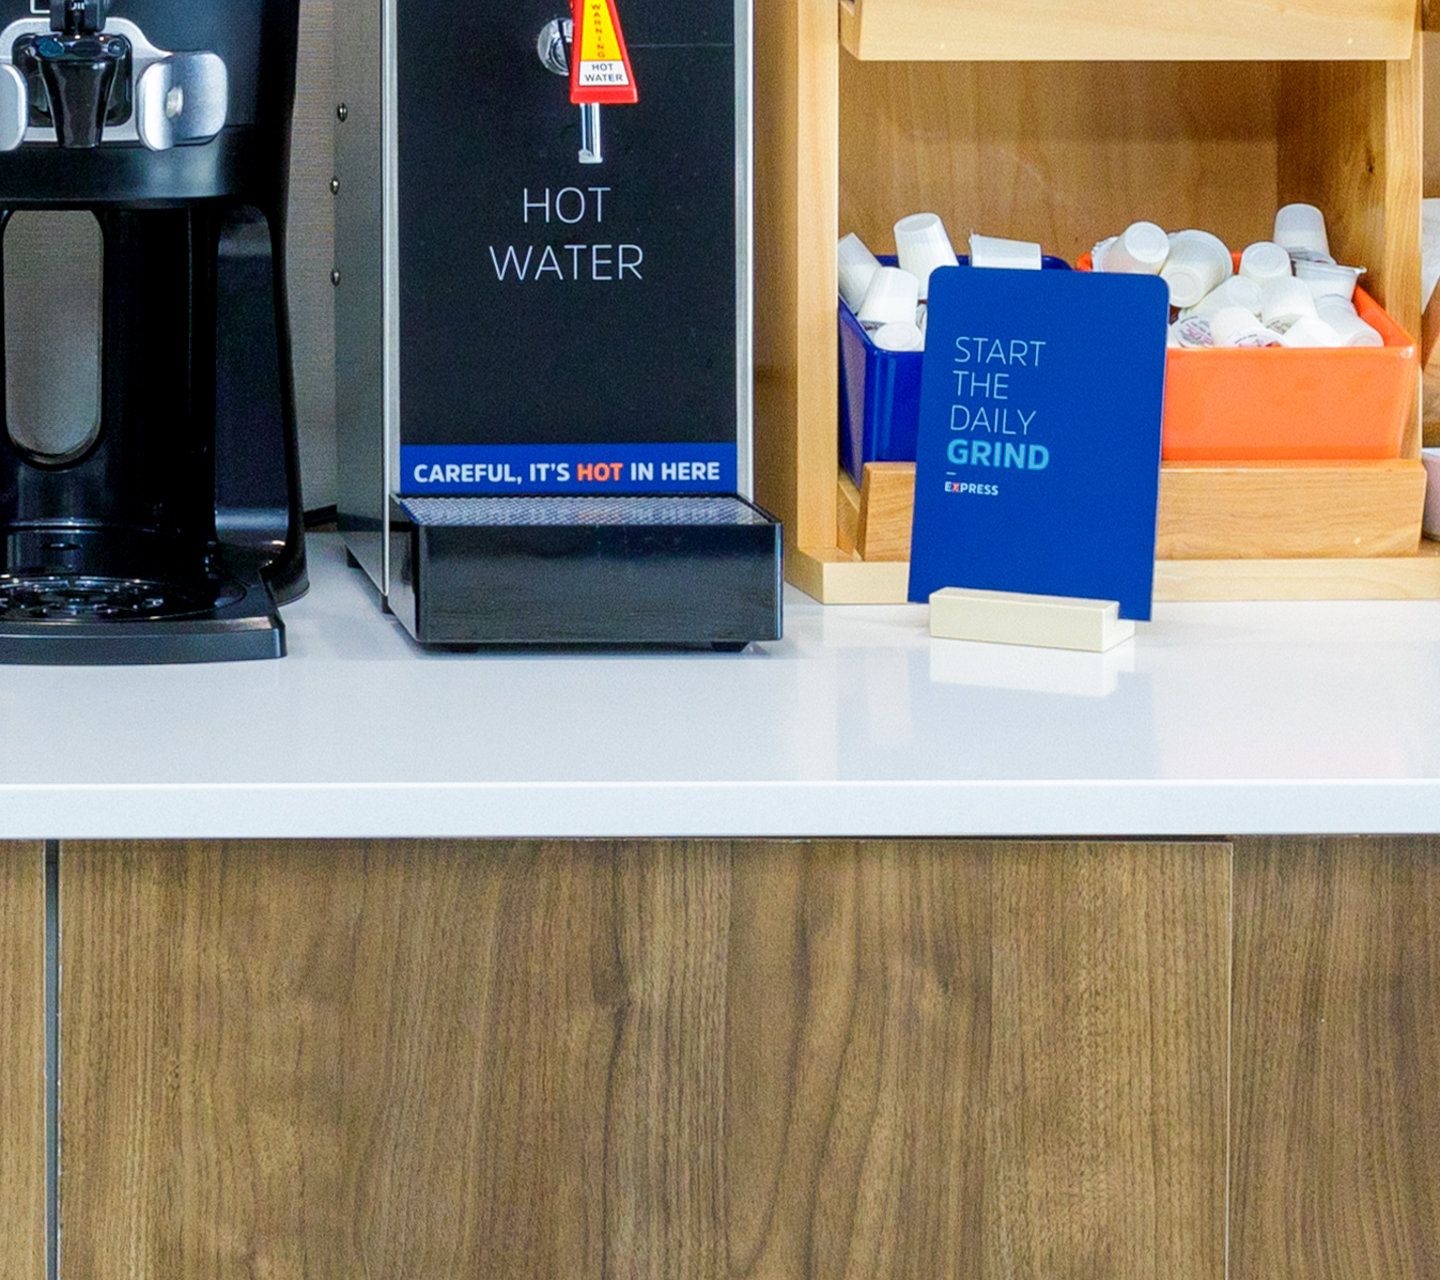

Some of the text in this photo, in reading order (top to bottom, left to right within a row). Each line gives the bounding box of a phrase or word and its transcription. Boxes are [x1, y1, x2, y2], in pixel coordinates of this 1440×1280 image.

[585, 73, 623, 82] WATER
[592, 63, 614, 71] HOT
[523, 186, 611, 224] HOT
[489, 244, 644, 281] WATER
[954, 336, 1047, 367] START
[952, 370, 1010, 400] THE
[950, 404, 1037, 436] DAILY
[946, 438, 1051, 471] GRIND
[413, 462, 720, 485] CAREFUL, IT'S HOT IN HERE
[944, 481, 1000, 496] EXPRESS
